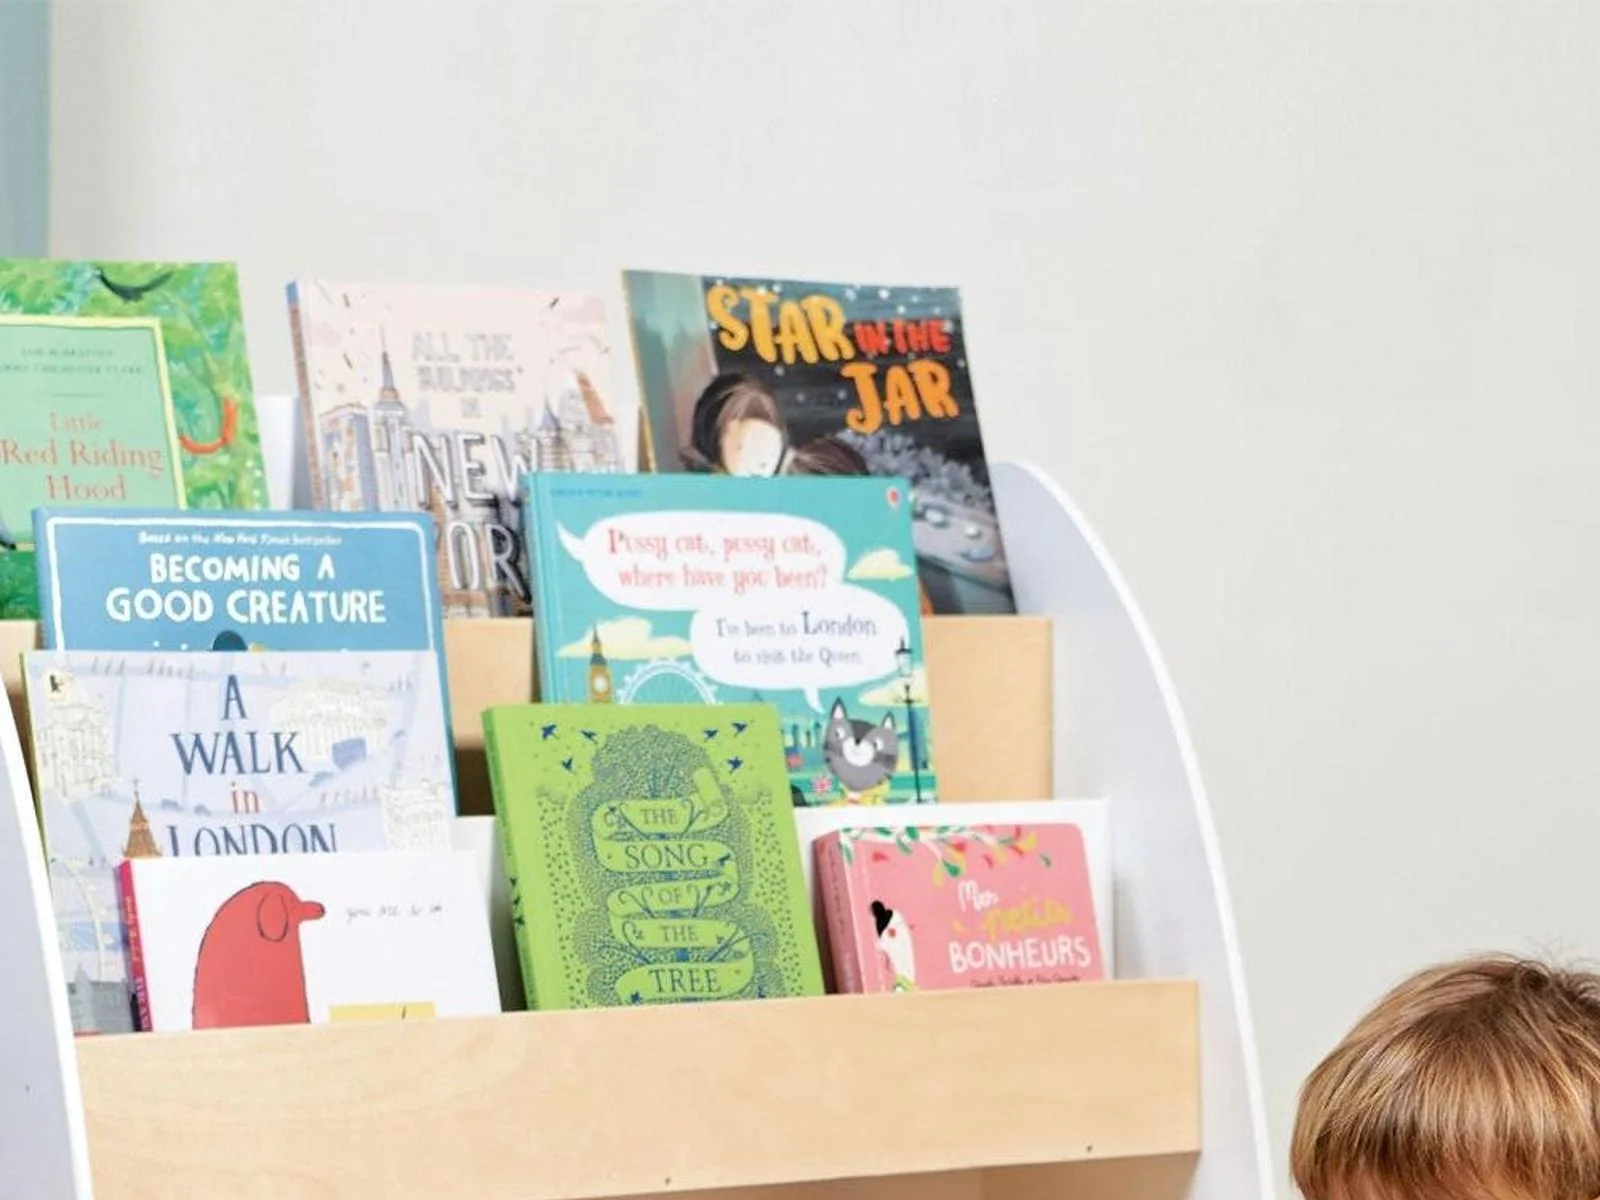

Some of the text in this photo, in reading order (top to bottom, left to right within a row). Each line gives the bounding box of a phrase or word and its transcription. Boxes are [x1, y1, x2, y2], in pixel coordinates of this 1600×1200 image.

[707, 283, 952, 364] STAR IN THE
[411, 332, 514, 363] ALL THE
[841, 358, 960, 433] JAR
[2, 439, 163, 477] Red Riding
[409, 432, 539, 510] NEW
[47, 474, 127, 500] Hood
[608, 528, 823, 563] Pussy cat, pussy cat,
[149, 553, 335, 584] BECOMING A
[618, 562, 828, 595] where have you been?
[105, 587, 387, 625] GOOD CREATURE
[744, 619, 776, 637] been
[780, 621, 797, 636] to
[802, 611, 877, 637] London
[733, 649, 752, 663] to
[790, 647, 814, 663] the
[220, 673, 249, 721] A
[169, 730, 306, 776] WALK
[229, 781, 260, 814] in
[639, 806, 680, 826] THE
[166, 822, 338, 857] LONDON
[624, 844, 709, 870] SONG
[657, 886, 684, 906] OF
[659, 925, 699, 942] THE
[948, 934, 1093, 974] BONHEURS
[648, 969, 722, 995] TREE
